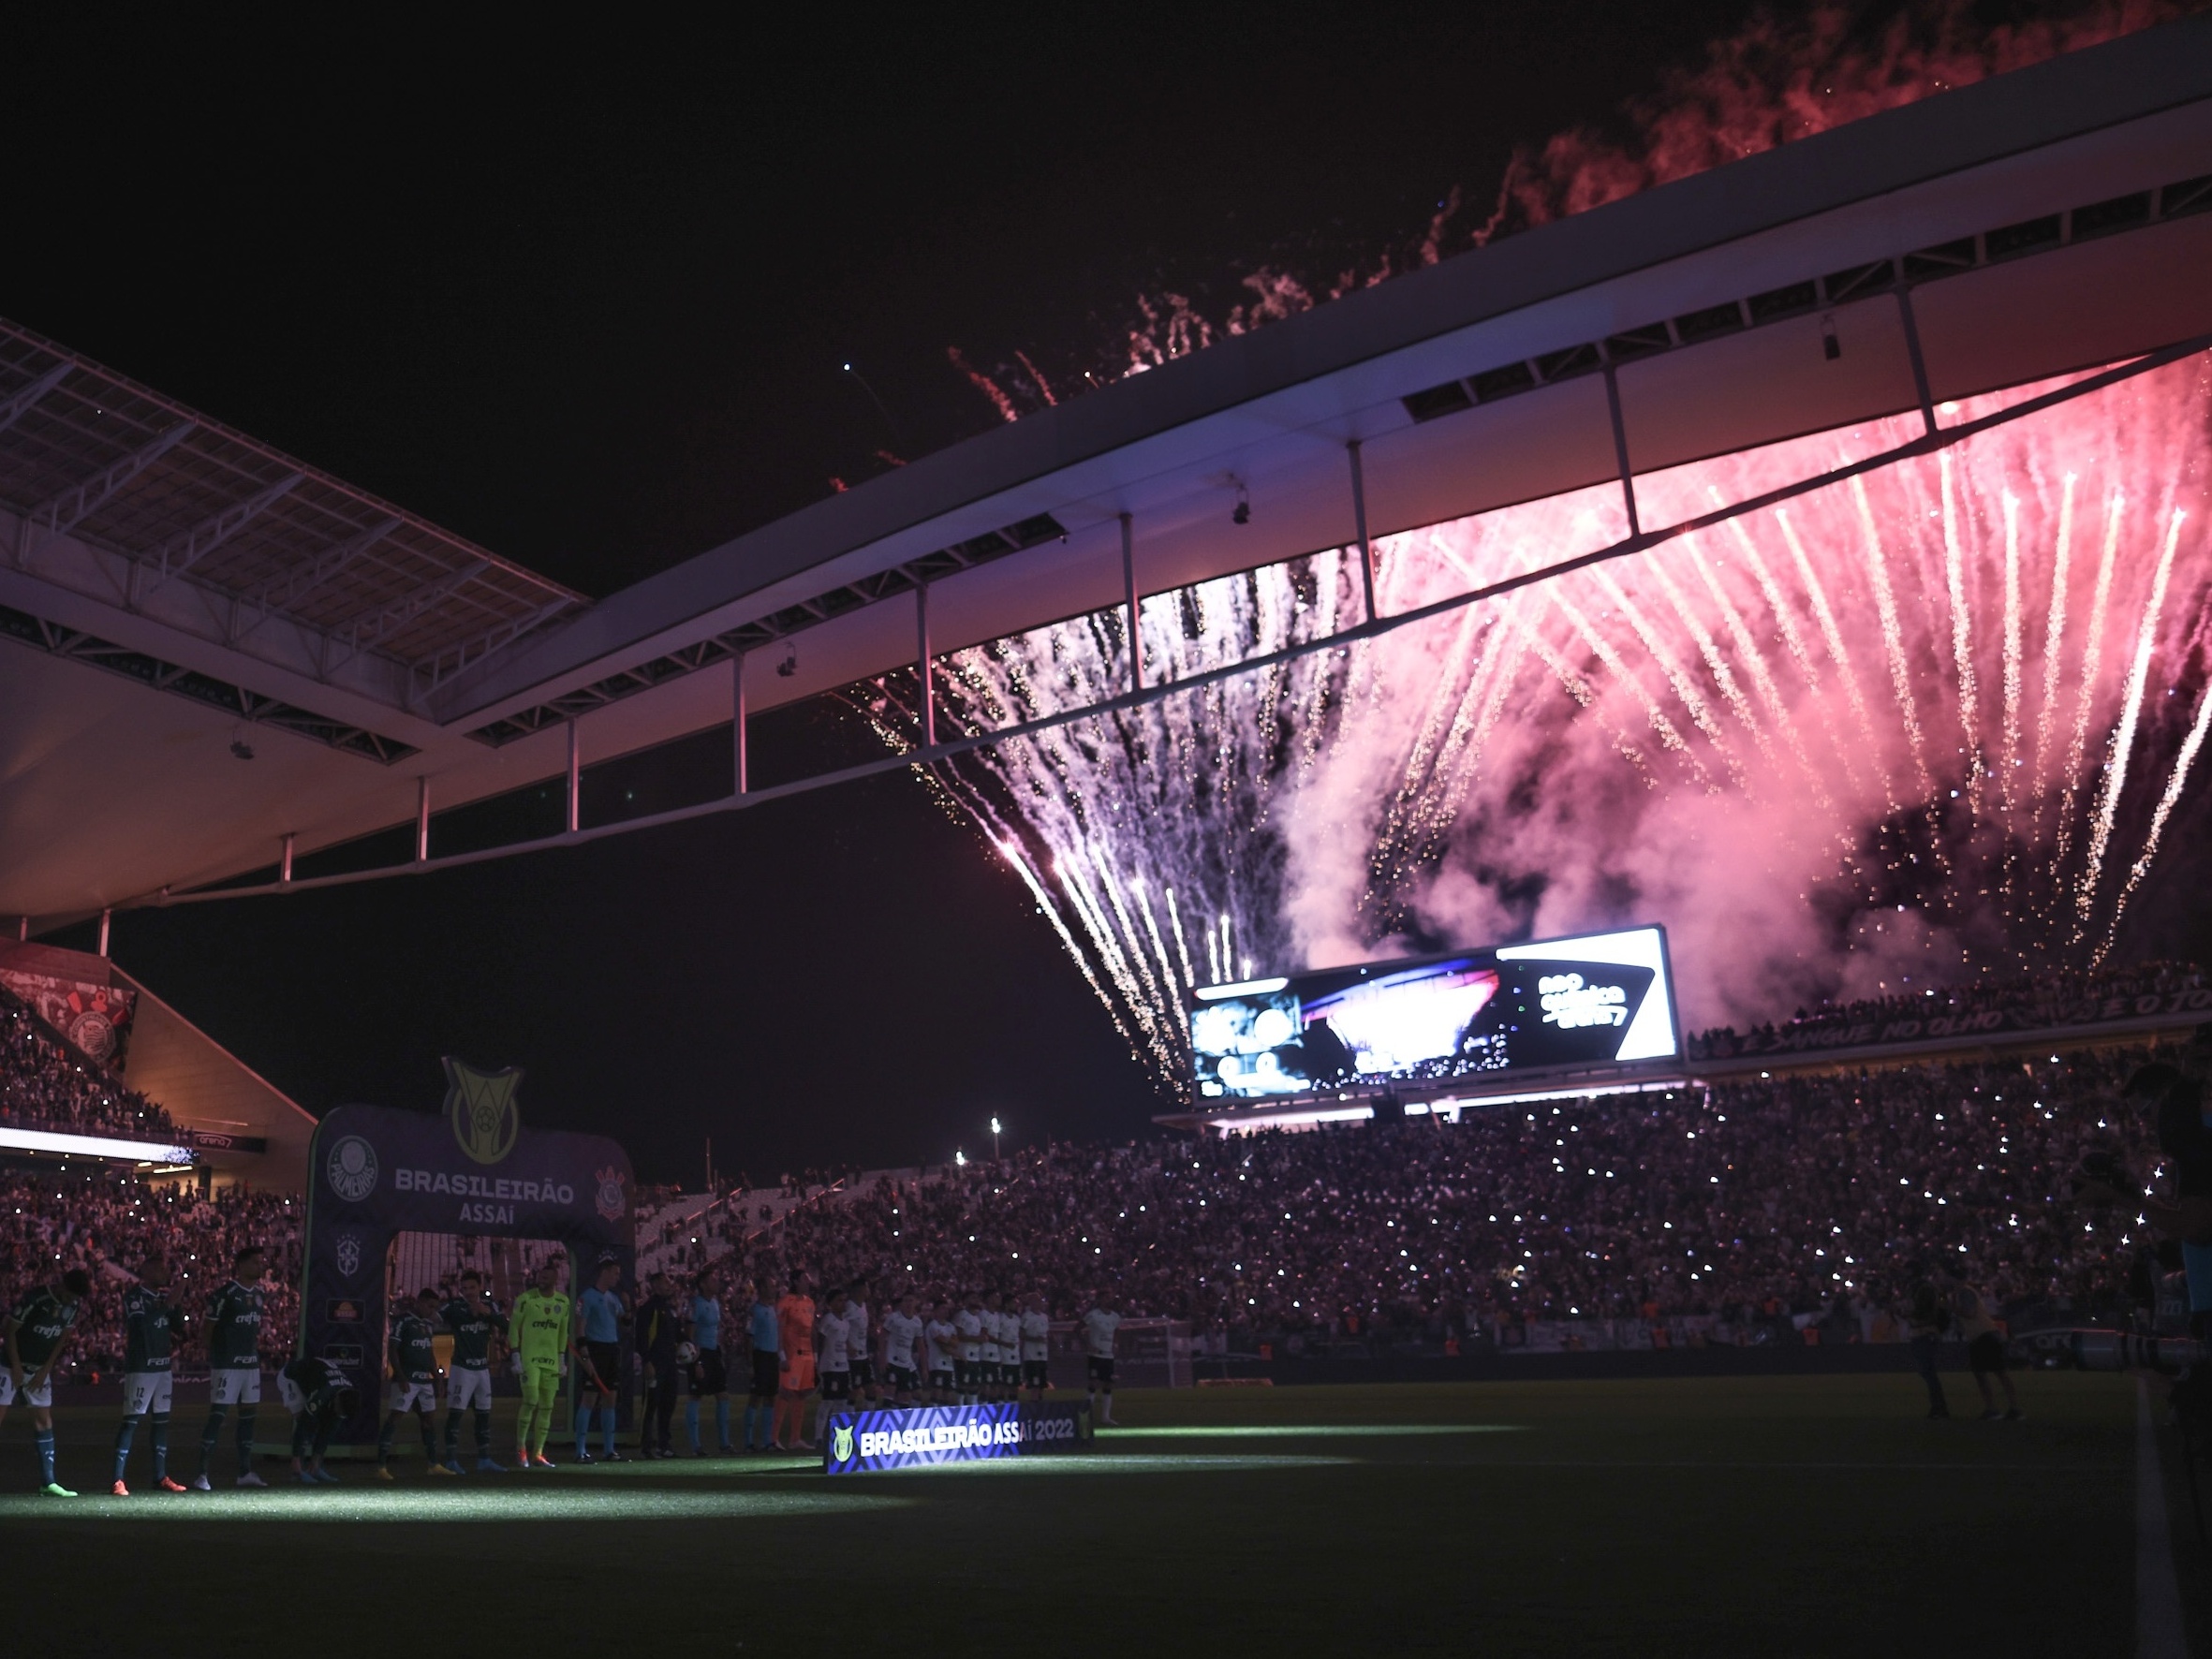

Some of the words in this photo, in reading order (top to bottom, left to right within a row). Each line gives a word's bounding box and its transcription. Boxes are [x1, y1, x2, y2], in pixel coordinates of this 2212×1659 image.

[330, 1163, 376, 1197] PALMEIRAS
[394, 1167, 574, 1205] BRASILEIRÃO
[459, 1202, 515, 1225] ASSAÍ
[136, 1387, 145, 1398] 12
[860, 1417, 993, 1457] BRASILEIRÃO
[1035, 1418, 1074, 1441] 2022
